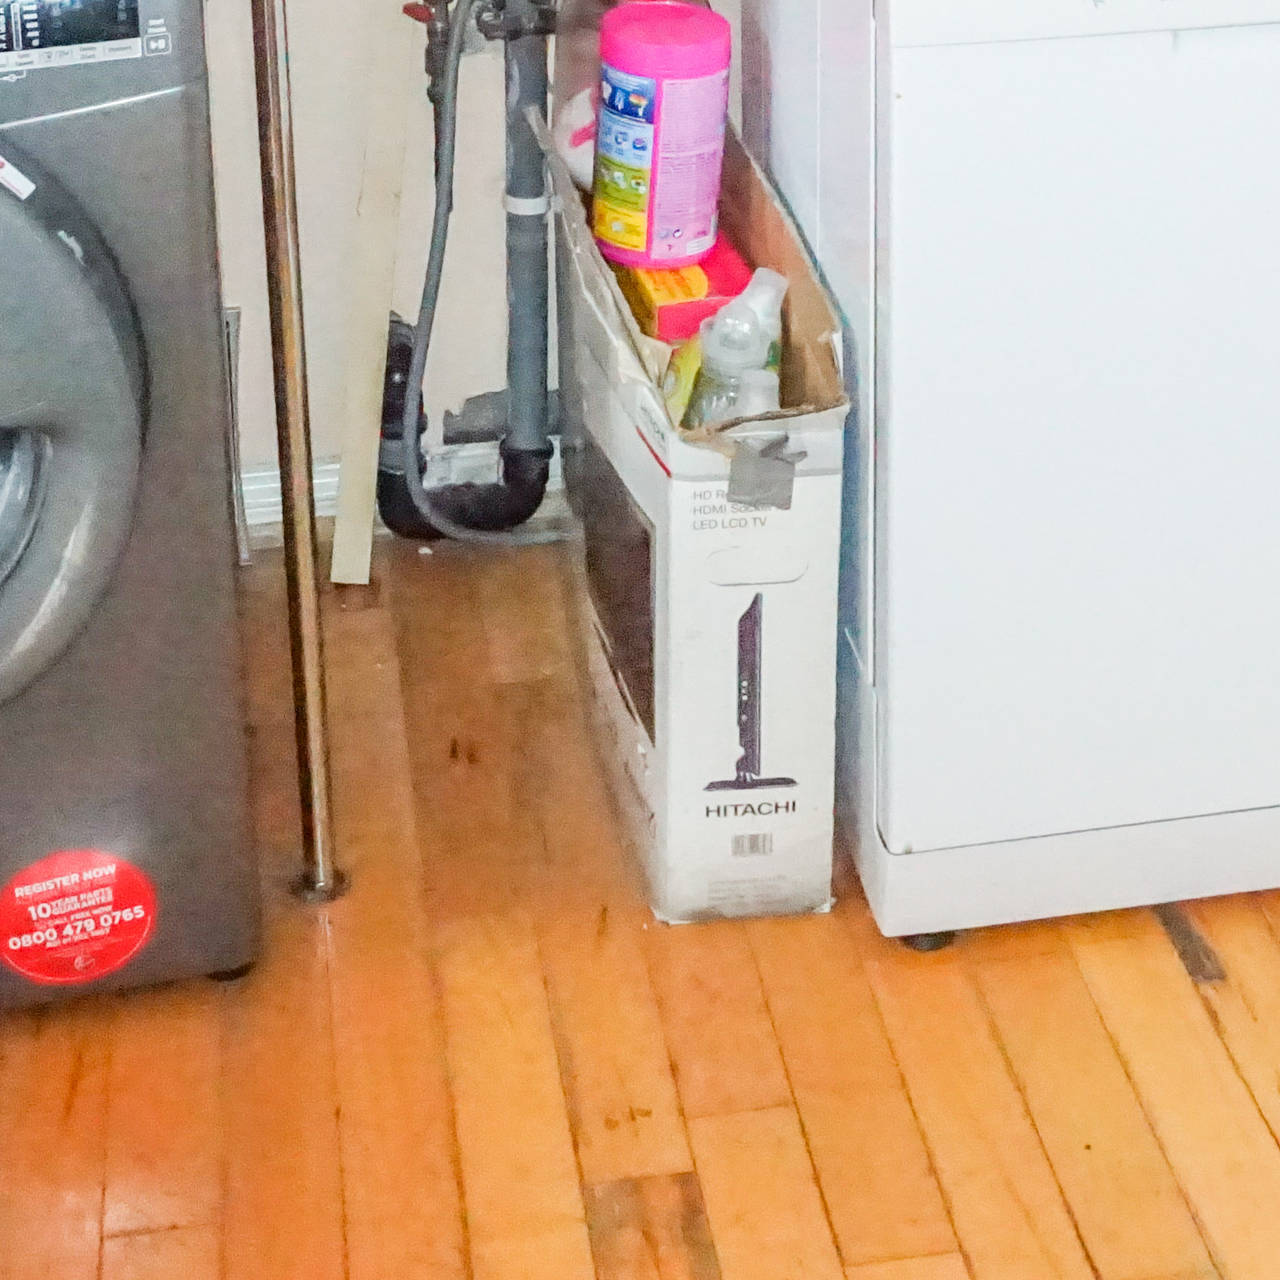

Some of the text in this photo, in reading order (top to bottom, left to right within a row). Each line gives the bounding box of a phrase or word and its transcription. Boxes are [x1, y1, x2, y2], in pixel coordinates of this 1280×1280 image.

[693, 489, 712, 501] HD
[693, 504, 727, 516] HDMI
[692, 516, 768, 531] LED LCD TV
[705, 800, 796, 818] HITACHI
[14, 873, 80, 898] REGISTER
[82, 863, 117, 881] NOW
[28, 902, 52, 921] 10
[8, 928, 58, 950] 0800
[62, 918, 96, 937] 479
[100, 905, 145, 928] 0765
